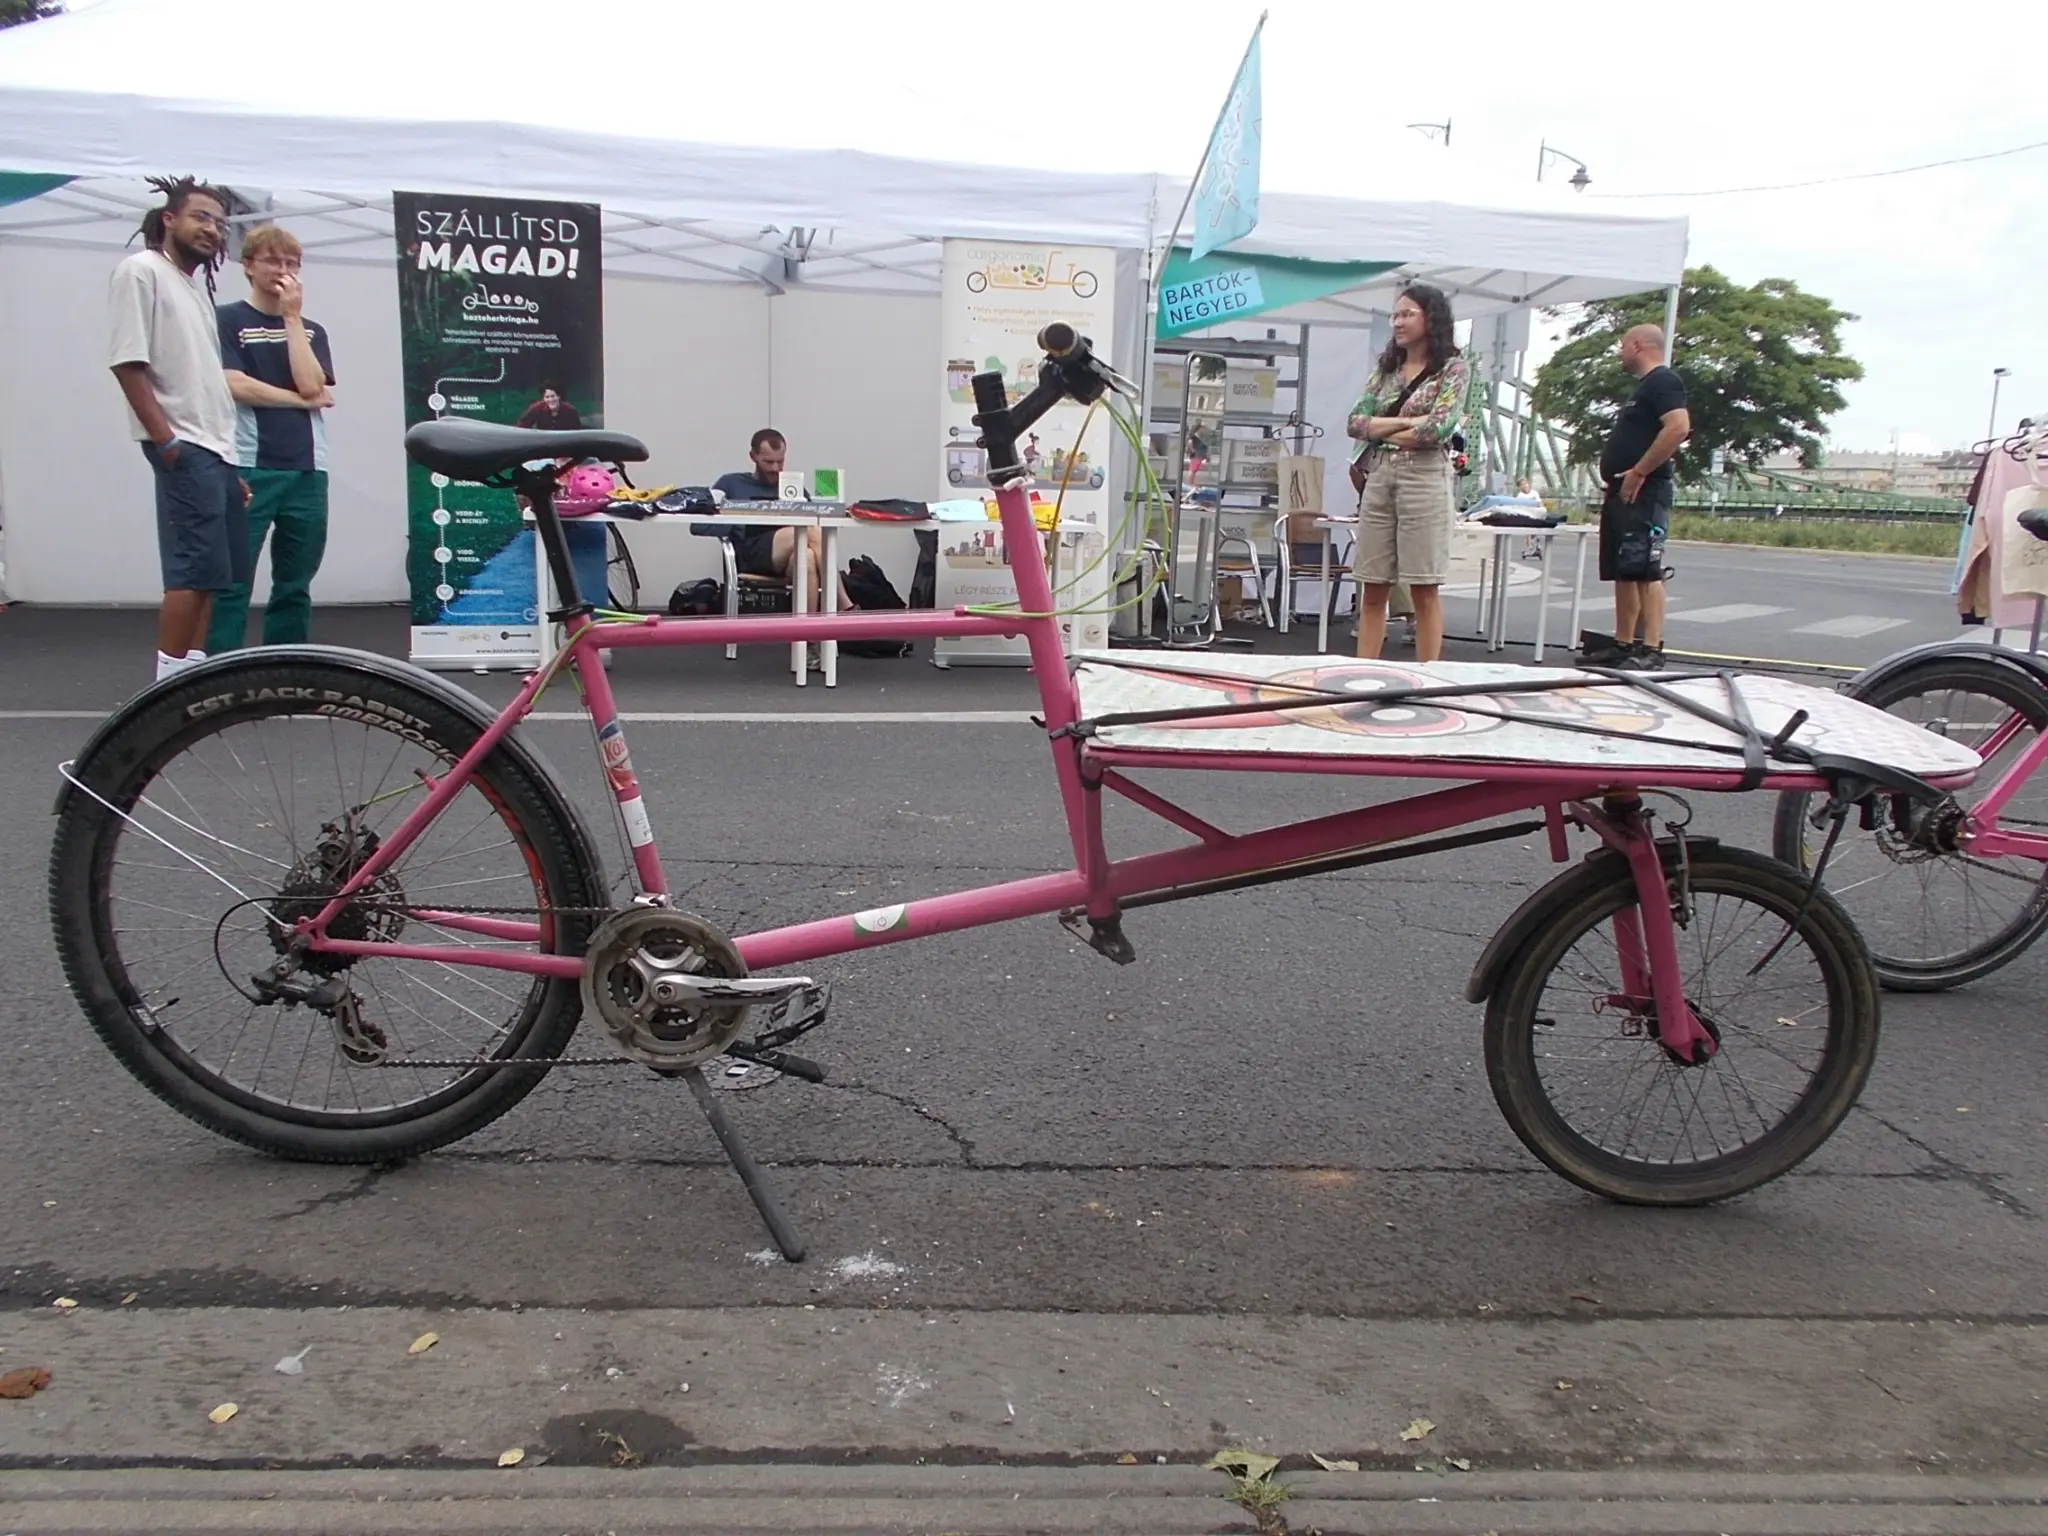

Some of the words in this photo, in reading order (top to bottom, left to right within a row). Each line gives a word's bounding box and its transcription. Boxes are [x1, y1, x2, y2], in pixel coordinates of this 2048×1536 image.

[417, 208, 580, 243] SZÁLLÍTSD
[417, 241, 580, 279] MAGAD!
[1169, 292, 1248, 325] NEGYED
[187, 692, 235, 717] CST
[241, 687, 316, 702] JACK
[324, 690, 433, 731] RABBIT
